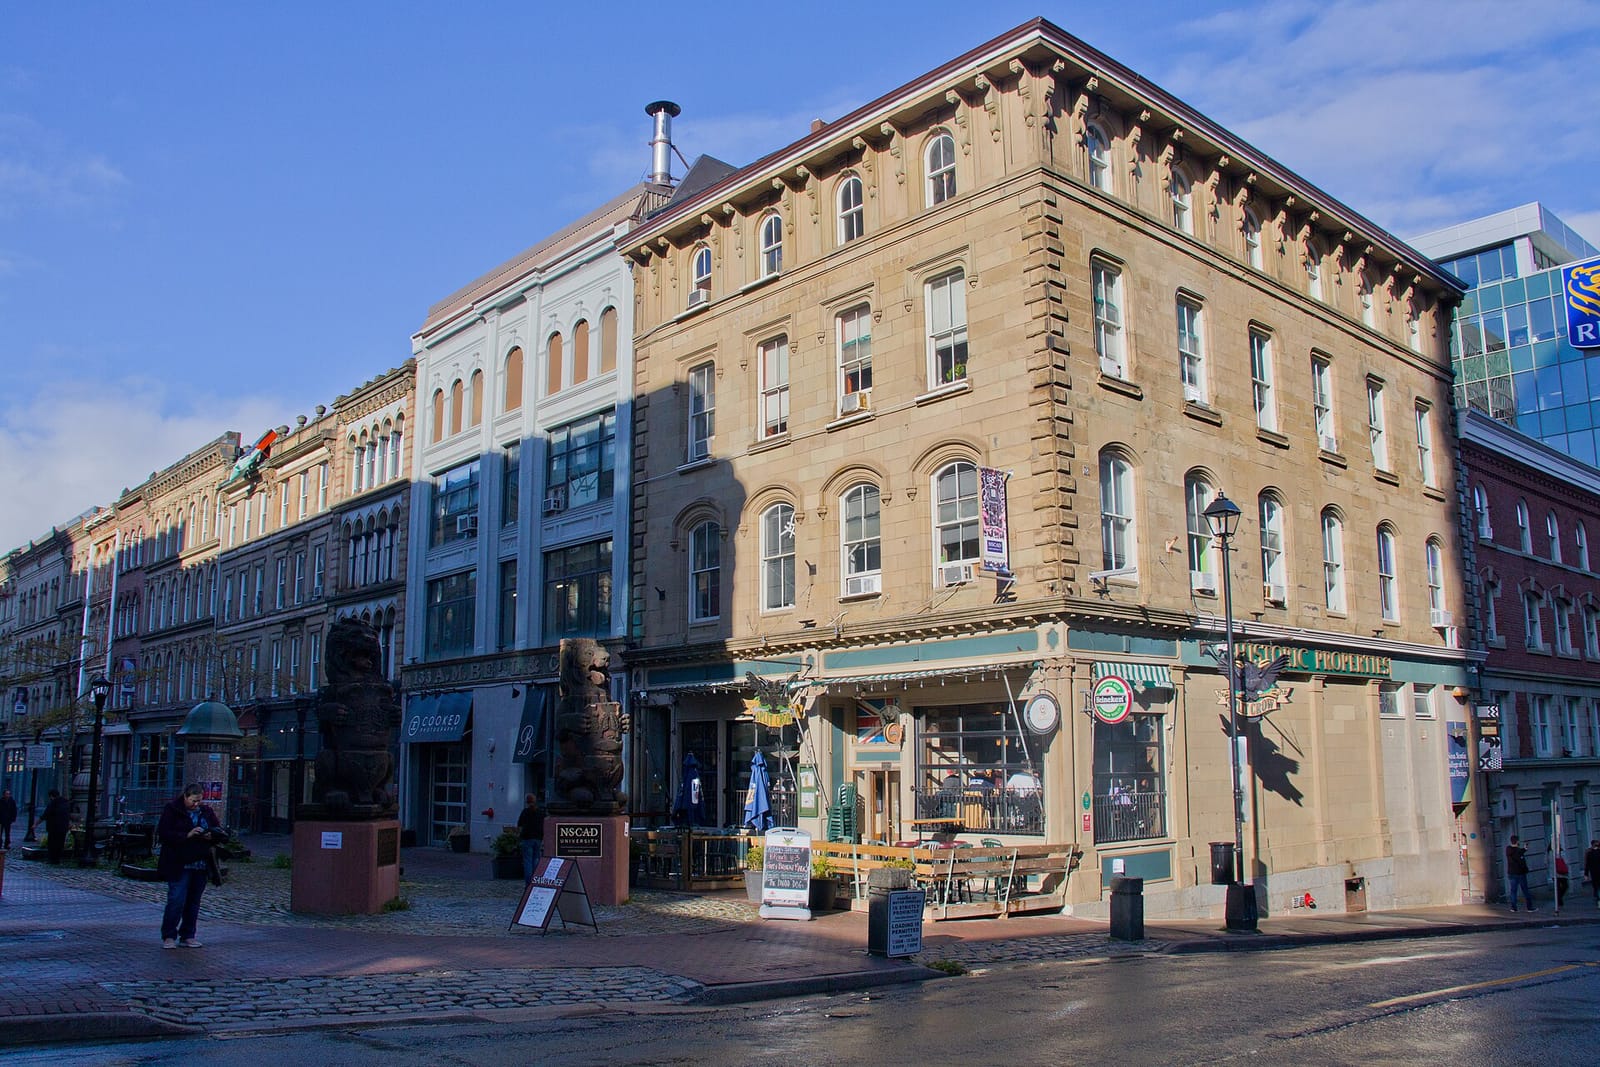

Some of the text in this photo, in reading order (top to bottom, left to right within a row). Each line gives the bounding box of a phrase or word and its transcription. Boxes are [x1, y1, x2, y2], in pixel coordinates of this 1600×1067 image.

[1234, 643, 1391, 675] HISTORIC PROPERTIES
[1096, 695, 1124, 704] Heineken
[1250, 698, 1275, 715] CROW
[422, 714, 461, 727] COOKED
[560, 827, 599, 837] NSCAD
[891, 927, 920, 935] PERMITTED
